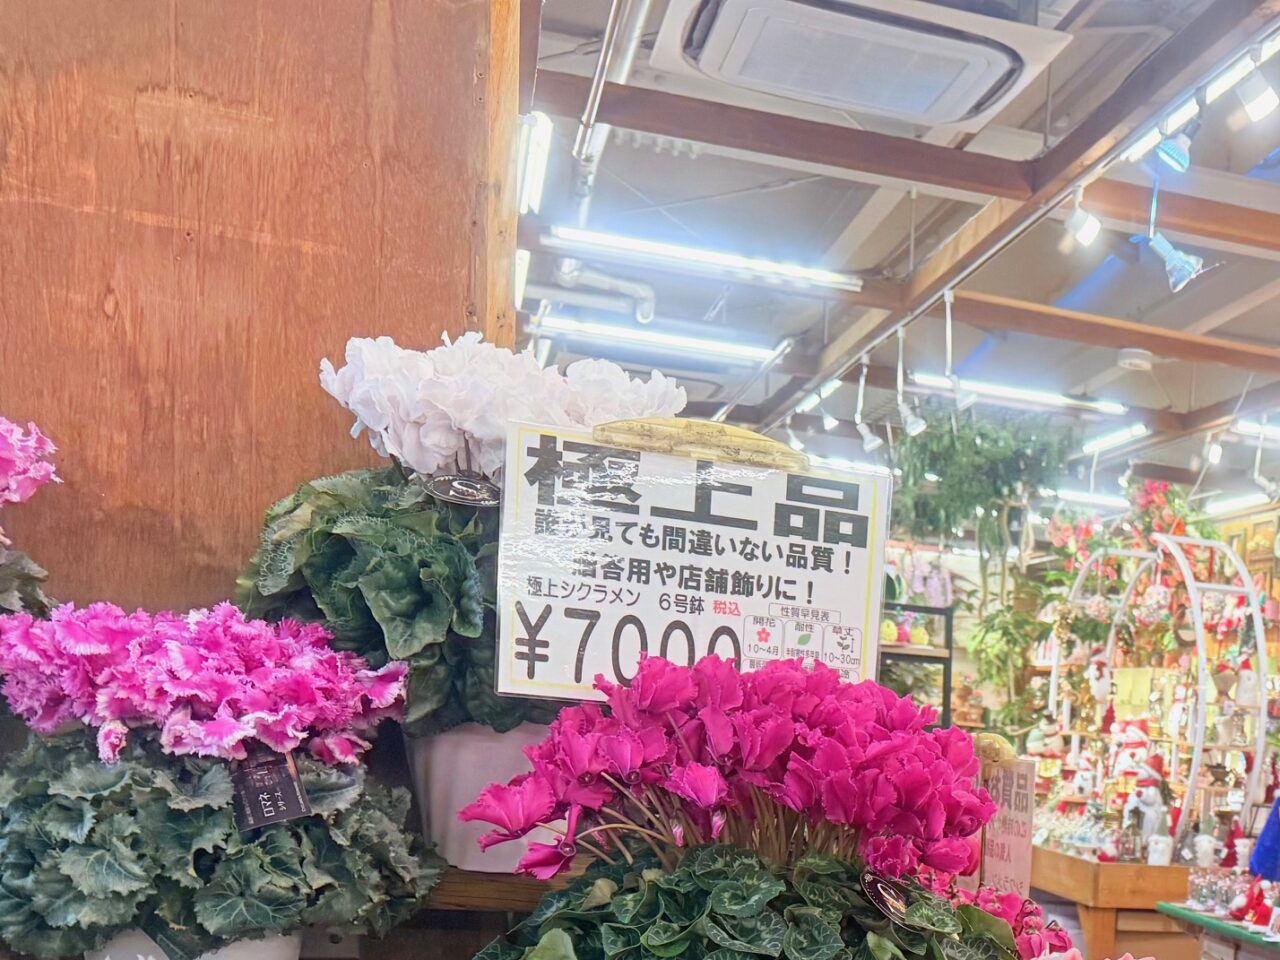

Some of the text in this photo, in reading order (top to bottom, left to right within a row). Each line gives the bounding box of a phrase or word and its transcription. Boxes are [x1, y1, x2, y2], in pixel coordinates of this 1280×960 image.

[523, 433, 870, 549] 極上品
[533, 508, 852, 575] 誰見ても間違いない品質！
[526, 575, 742, 617] 極上シクラメン 6号鉢 税込
